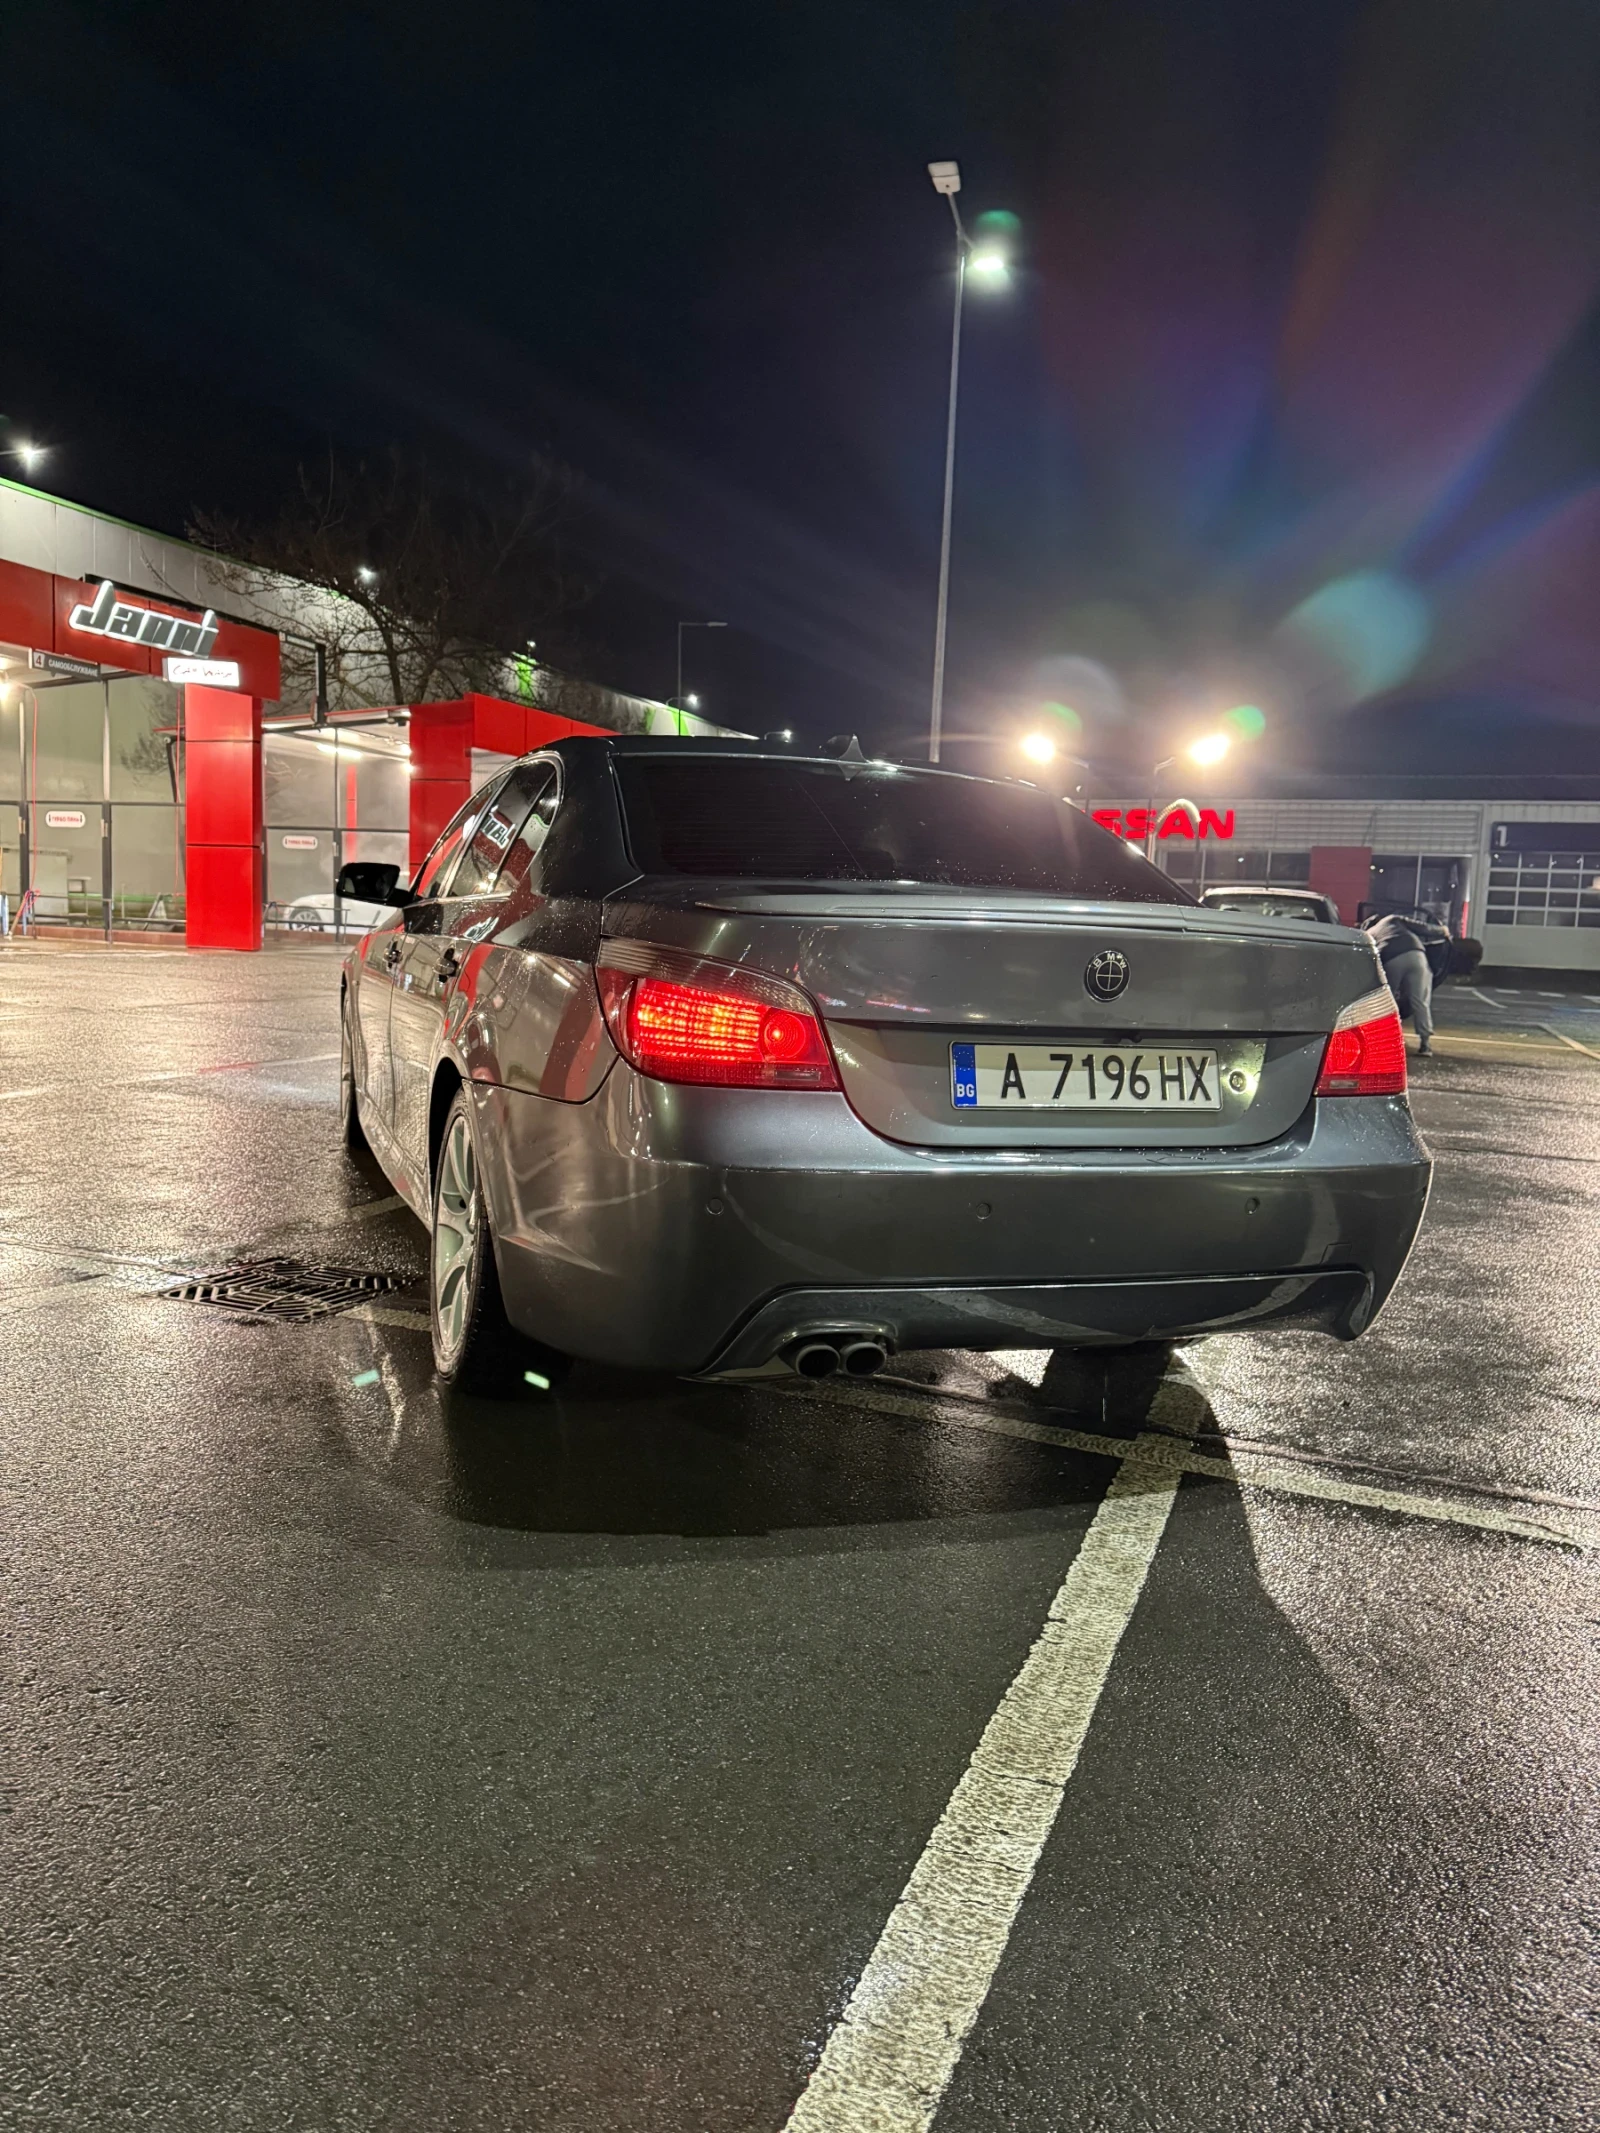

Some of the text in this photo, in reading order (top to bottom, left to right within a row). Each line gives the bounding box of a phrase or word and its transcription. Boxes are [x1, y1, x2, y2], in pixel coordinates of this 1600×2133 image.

[35, 655, 42, 666] 4
[1081, 808, 1235, 840] SSAN
[1496, 825, 1508, 847] 1
[956, 1083, 975, 1098] BG
[1001, 1052, 1026, 1099] A
